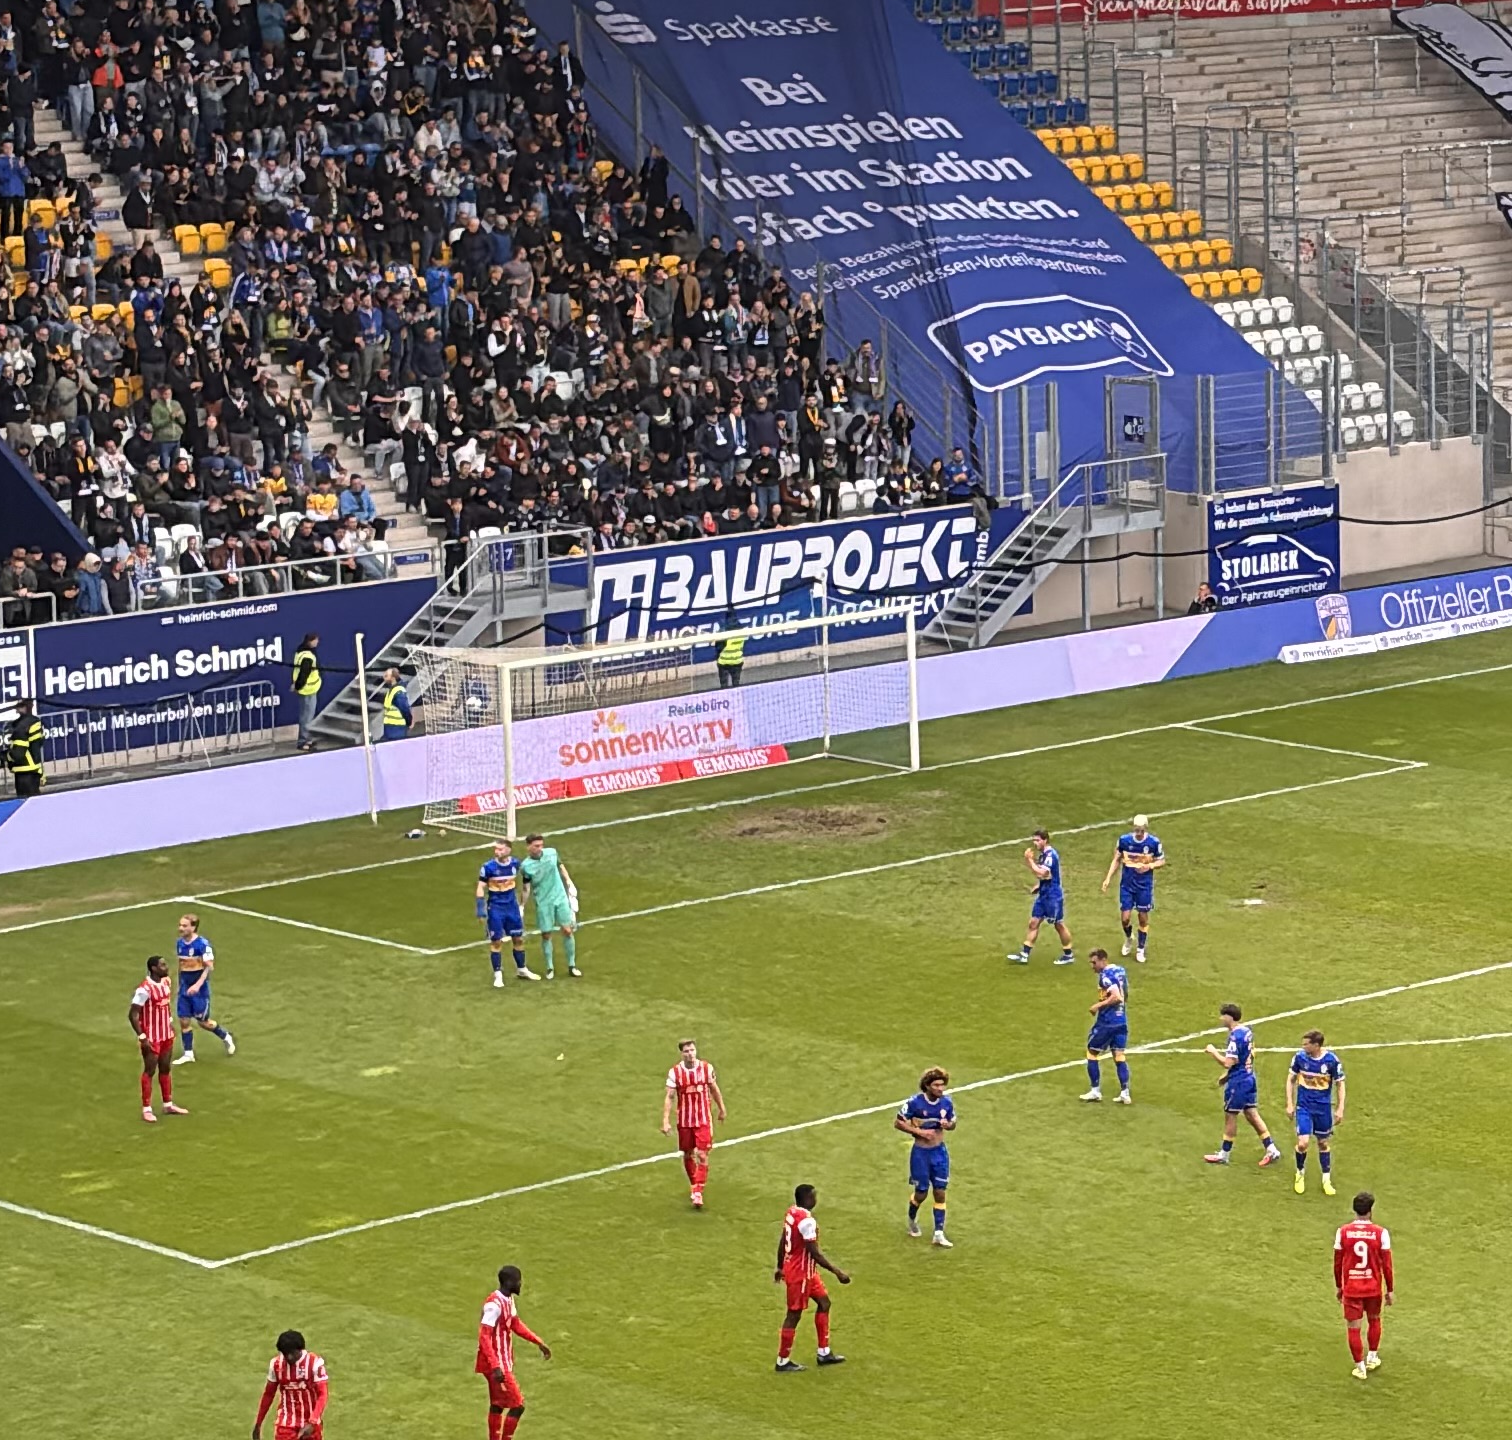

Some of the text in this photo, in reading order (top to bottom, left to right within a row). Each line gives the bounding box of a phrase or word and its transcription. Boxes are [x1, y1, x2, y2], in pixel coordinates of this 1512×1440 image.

[664, 11, 838, 46] Sparkasse
[741, 74, 827, 108] Bei
[687, 109, 963, 157] Heimspielen
[700, 152, 1032, 202] hier im Stadion
[963, 316, 1100, 365] PAYBACK
[178, 603, 278, 625] heinrich-schmid.com
[1221, 595, 1239, 606] Der
[1380, 580, 1492, 629] Offizieller
[44, 636, 283, 697] Heinrich Schmid
[693, 749, 771, 775] REMONDIS
[583, 766, 661, 796] REMONDIS
[1354, 1240, 1370, 1269] 9
